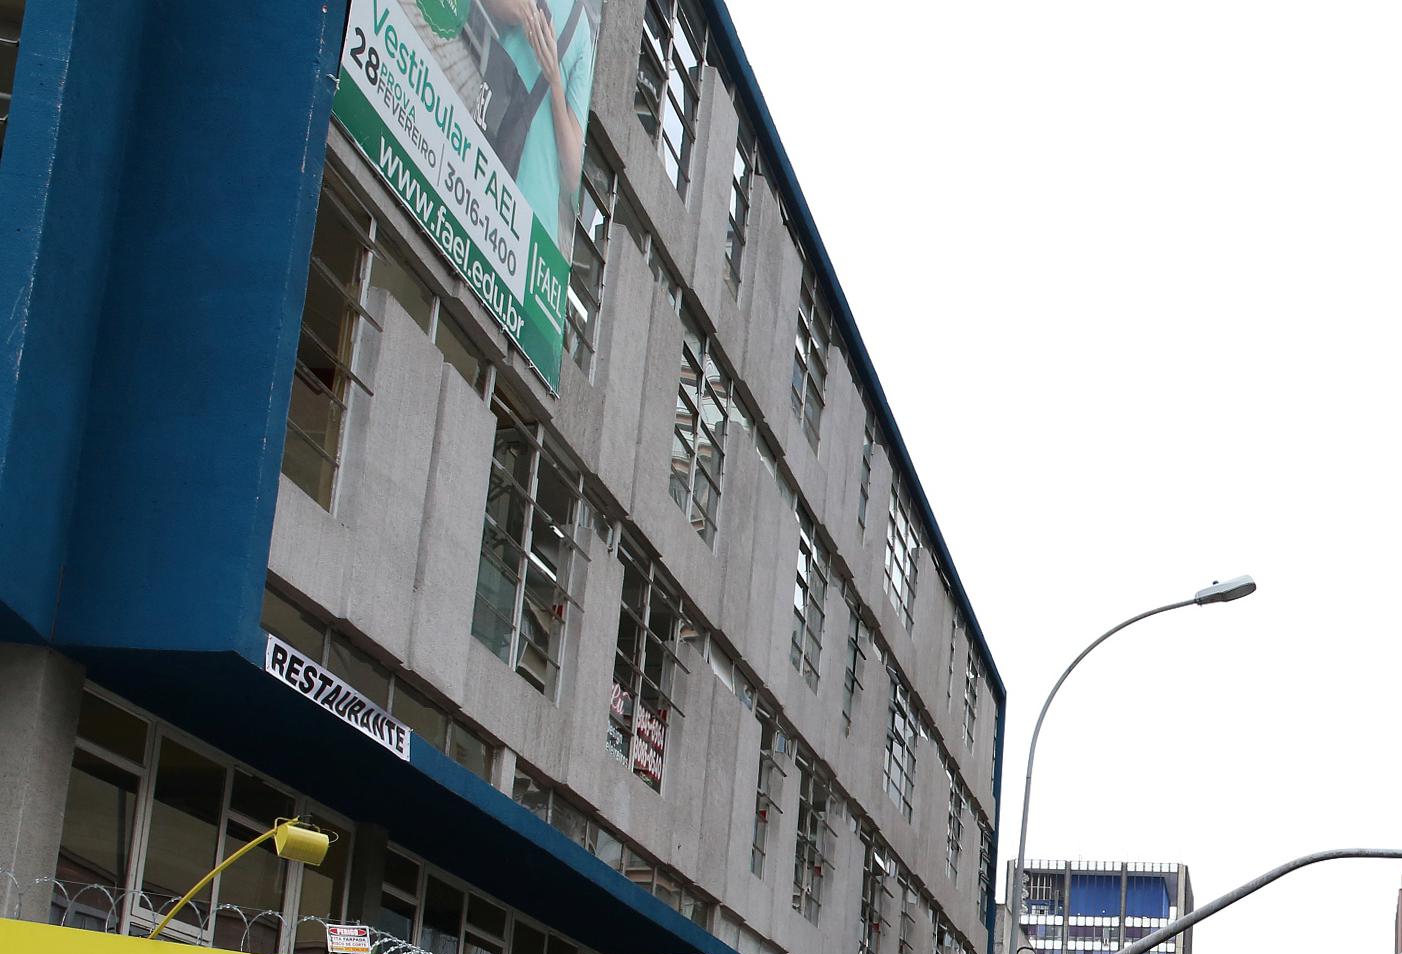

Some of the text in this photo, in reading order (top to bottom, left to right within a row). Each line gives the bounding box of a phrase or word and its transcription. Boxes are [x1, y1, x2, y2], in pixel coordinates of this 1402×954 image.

[350, 27, 380, 87] 28
[380, 62, 416, 124] PROVA
[372, 0, 520, 241] Vestibular FAEL
[377, 77, 436, 169] FEVEREIRO
[379, 135, 525, 338] www.fael.edu.br
[444, 161, 517, 277] 3016-1400
[536, 256, 562, 319] FAEL
[272, 643, 405, 754] RESTAURANTE
